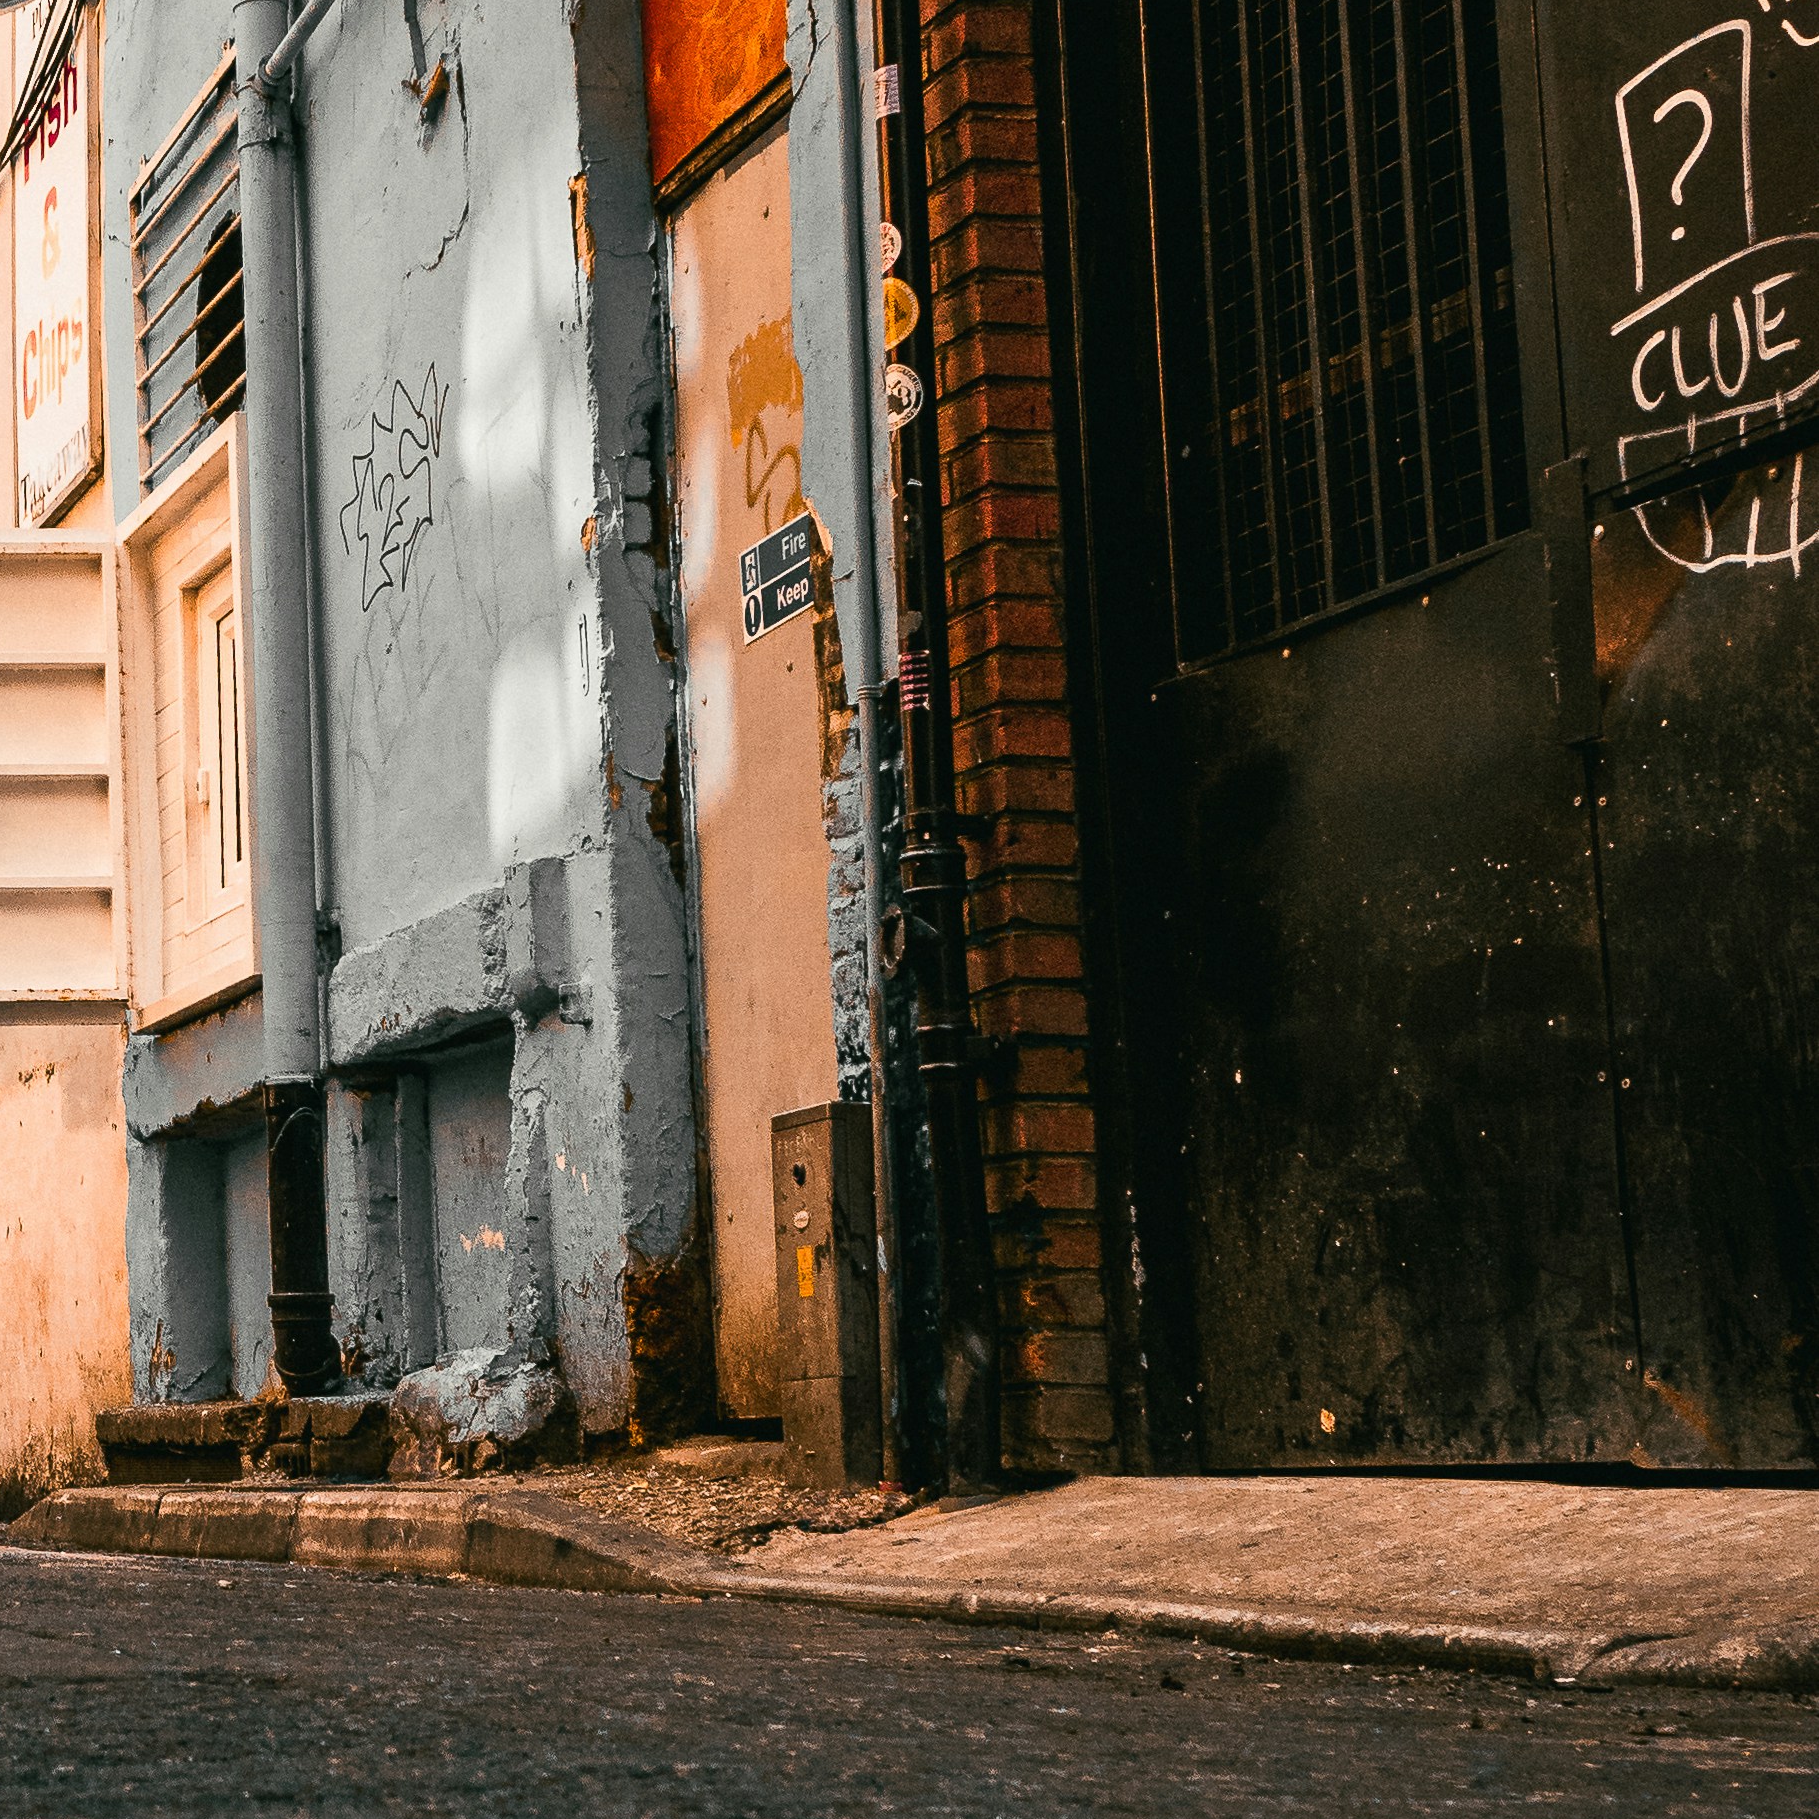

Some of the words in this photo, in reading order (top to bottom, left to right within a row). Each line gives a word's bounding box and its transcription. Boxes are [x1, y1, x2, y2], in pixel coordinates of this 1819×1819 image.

[42, 186, 61, 280] &
[22, 295, 84, 421] Chips
[1631, 270, 1802, 412] CLUE
[781, 532, 807, 561] Fire
[776, 577, 809, 611] Keep
